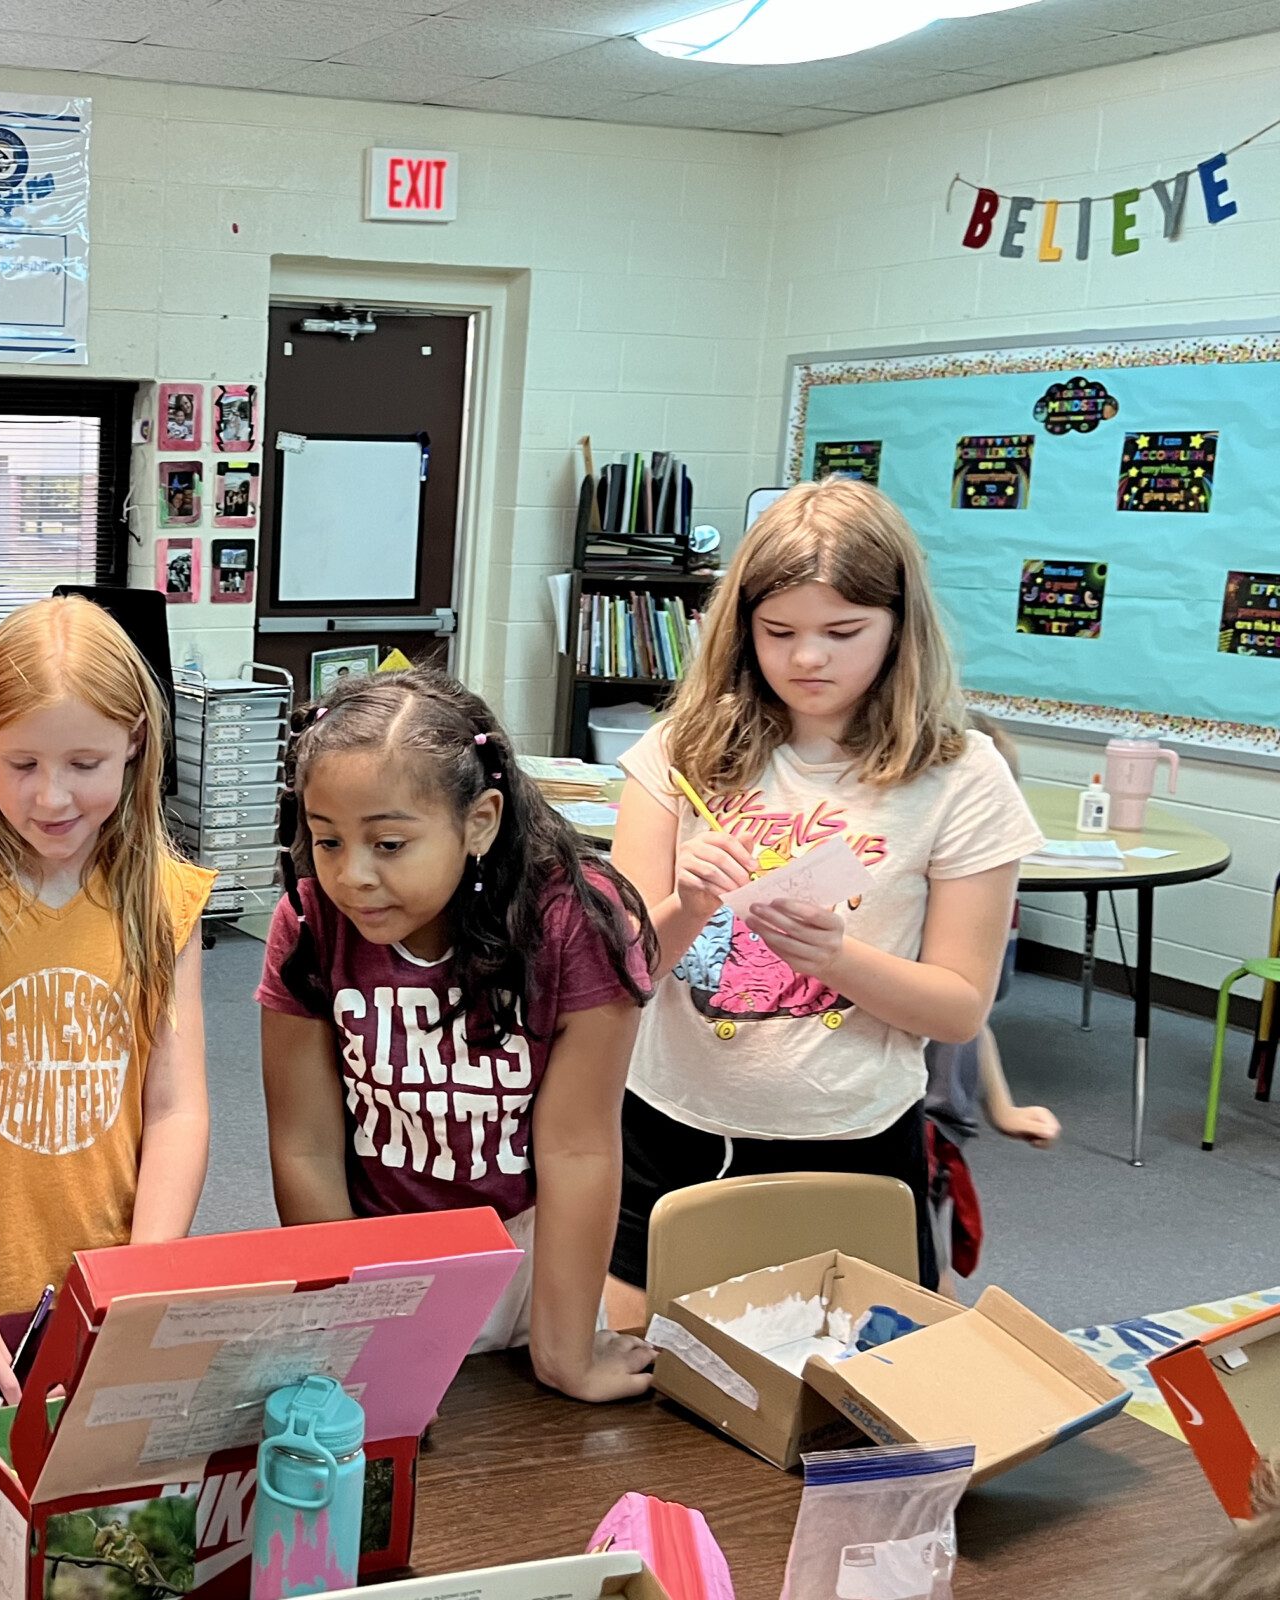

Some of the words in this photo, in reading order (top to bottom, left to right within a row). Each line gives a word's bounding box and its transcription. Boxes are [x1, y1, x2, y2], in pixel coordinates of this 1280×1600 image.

[387, 157, 448, 210] EXIT
[962, 152, 1237, 262] BELIEVE
[1048, 399, 1105, 412] MINDSET
